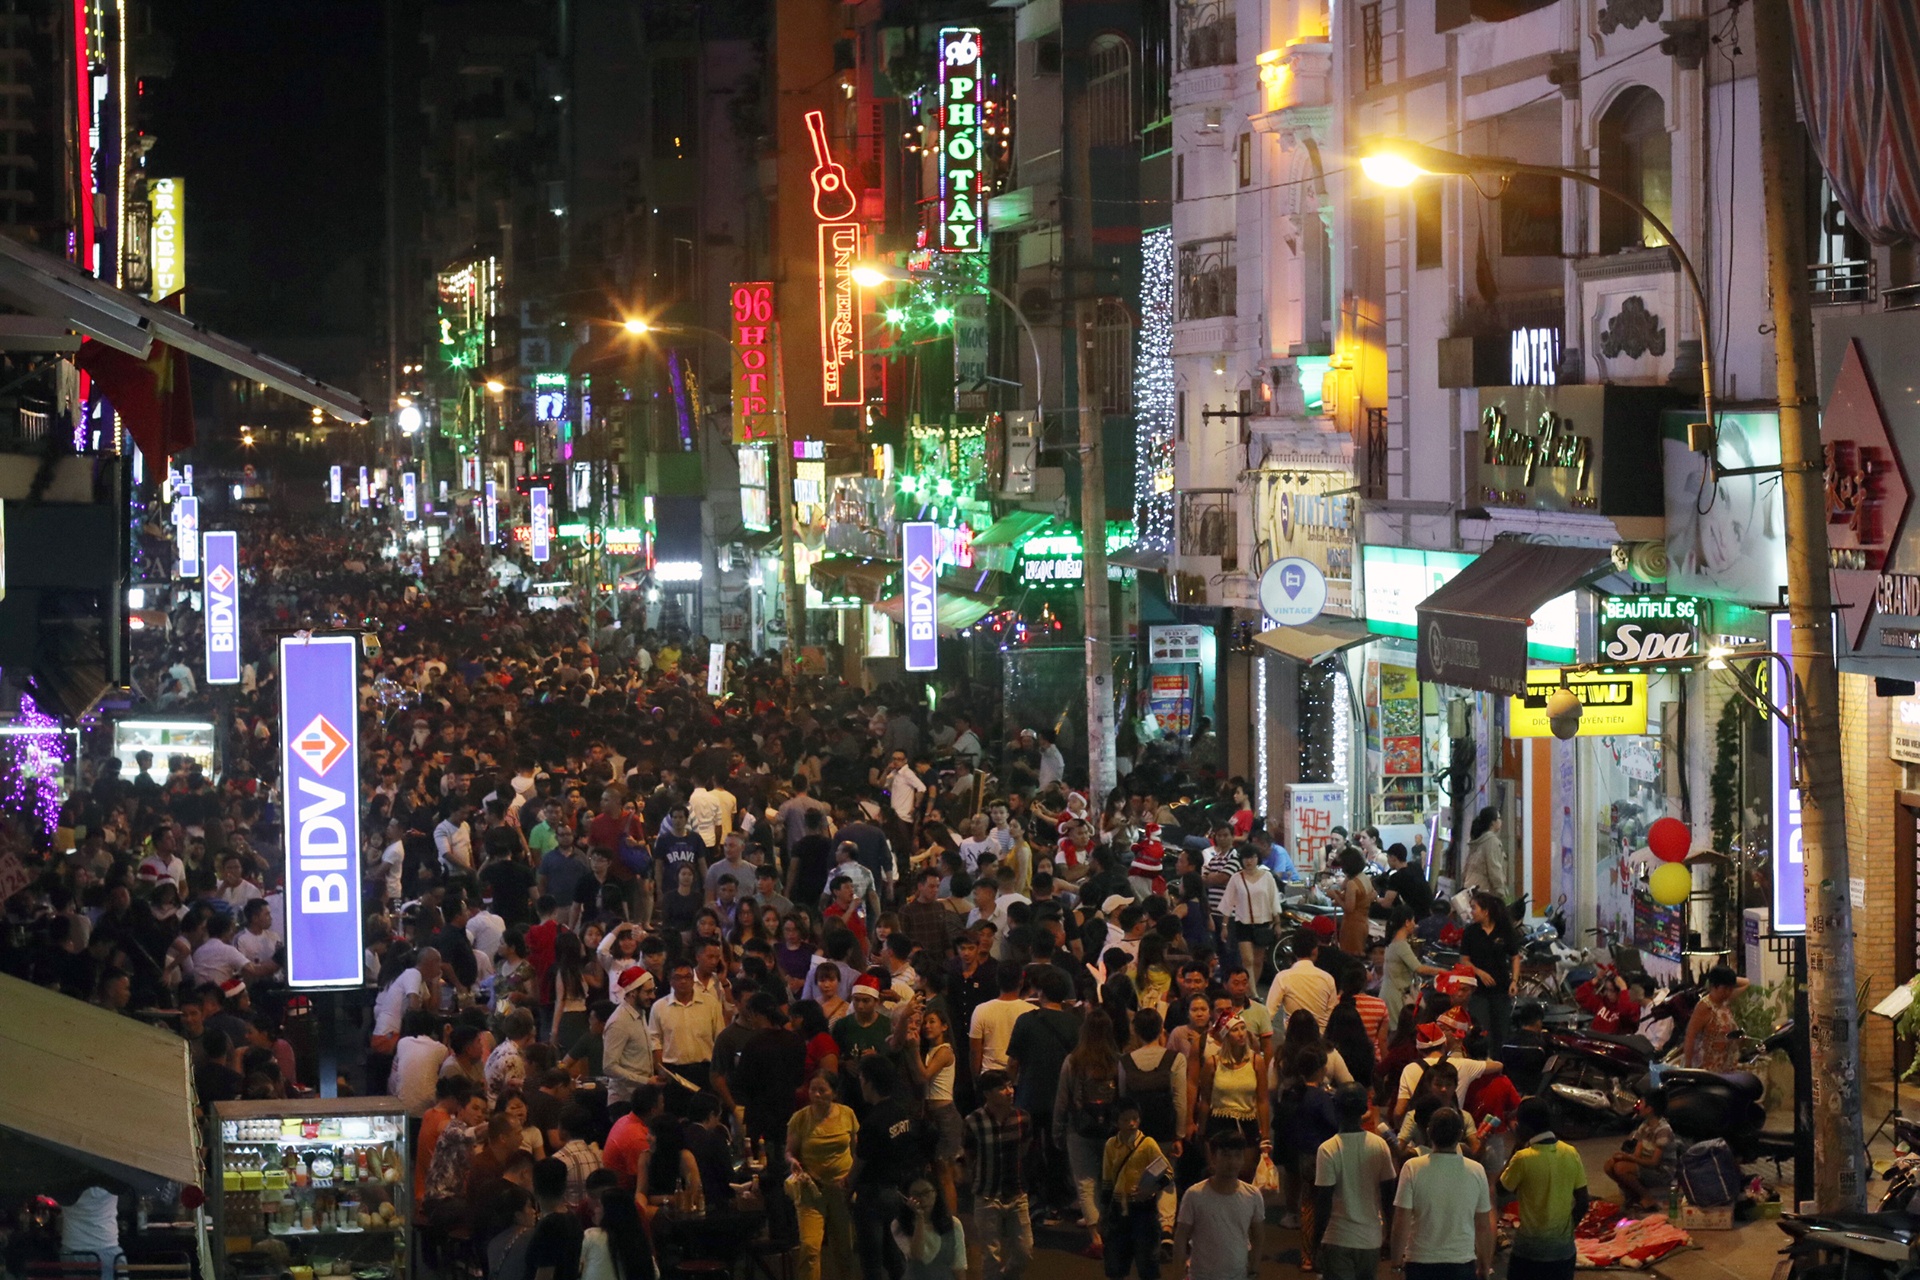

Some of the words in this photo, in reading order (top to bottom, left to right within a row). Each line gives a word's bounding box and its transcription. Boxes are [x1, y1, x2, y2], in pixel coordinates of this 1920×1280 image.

[947, 77, 976, 161] PHỐ
[946, 193, 977, 247] TÂY
[733, 287, 773, 323] 96
[1511, 326, 1556, 386] HOTEL
[210, 592, 234, 653] BIDV
[911, 582, 933, 641] BIDV
[1273, 607, 1313, 615] VINTAGE
[1606, 602, 1675, 619] BEAUTIFUL
[1675, 602, 1695, 617] SG
[1606, 624, 1693, 661] Spa
[298, 776, 349, 914] BIDV
